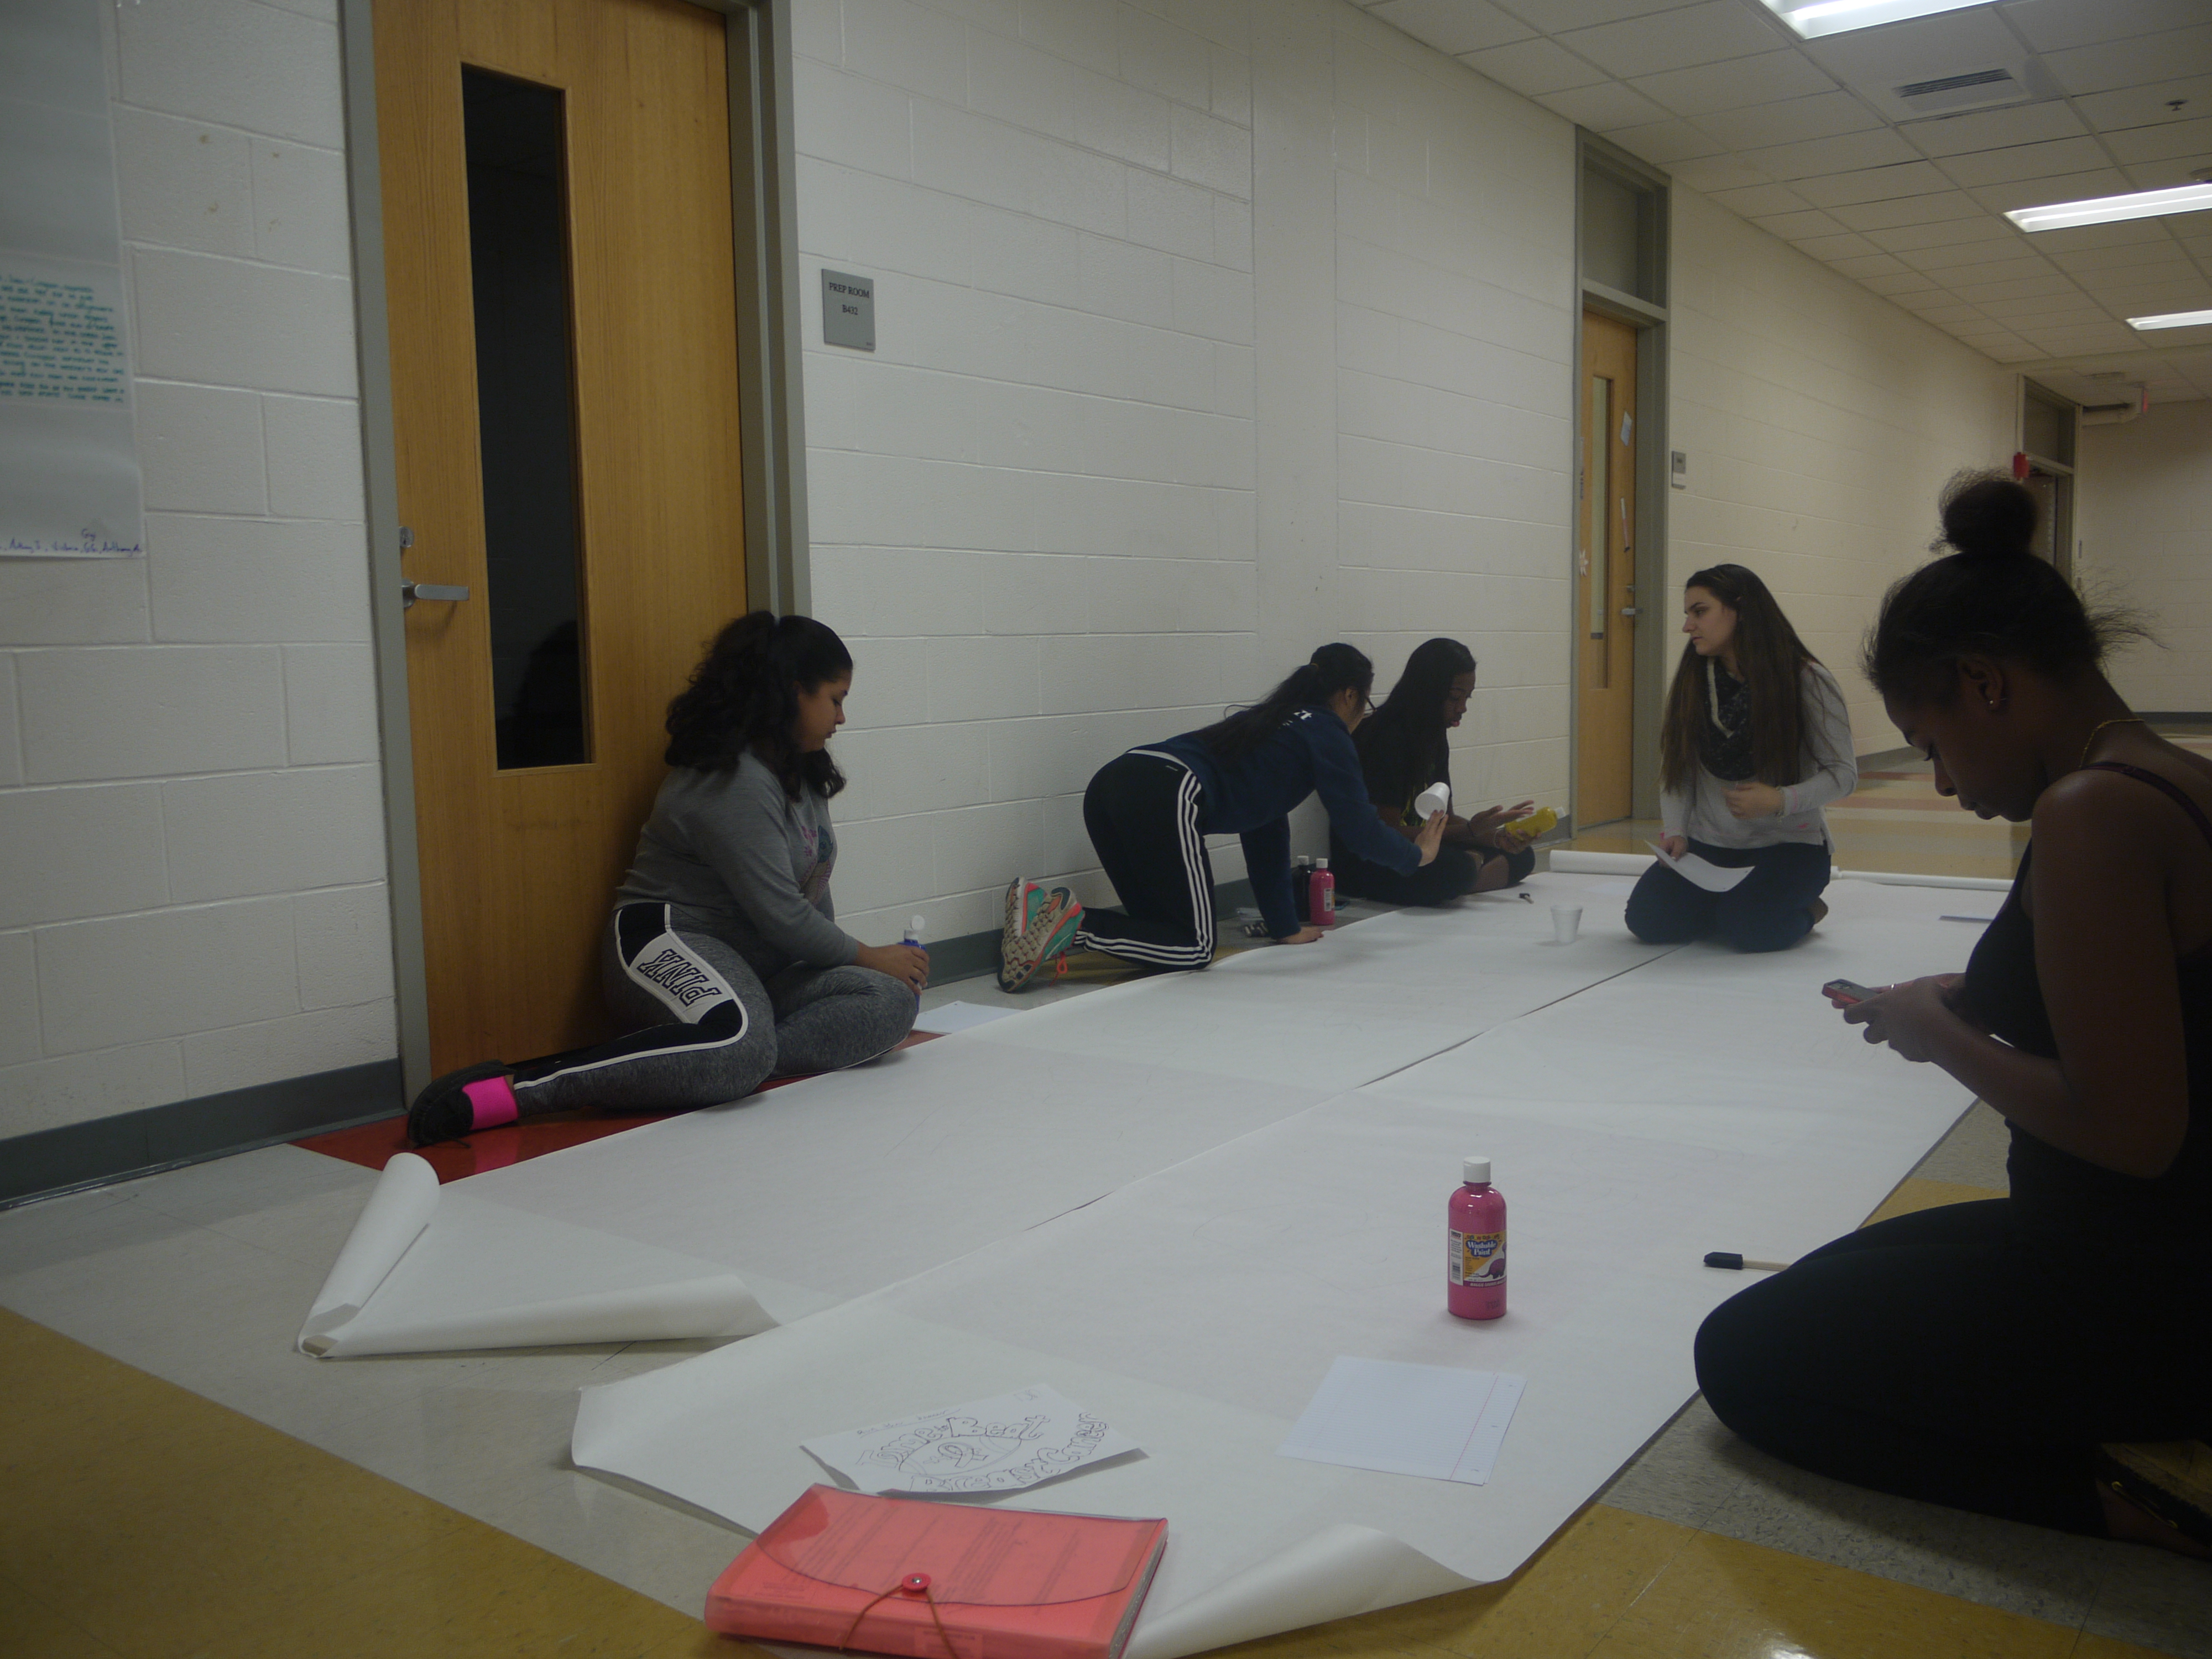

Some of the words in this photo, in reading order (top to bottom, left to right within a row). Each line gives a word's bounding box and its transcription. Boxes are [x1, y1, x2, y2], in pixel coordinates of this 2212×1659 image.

[829, 282, 847, 294] PREP
[848, 286, 869, 298] ROOM
[842, 305, 858, 315] B432
[637, 948, 722, 1006] PINK
[1467, 1240, 1496, 1249] Washable
[947, 1414, 1051, 1441] Beat
[909, 1457, 1061, 1493] Breast
